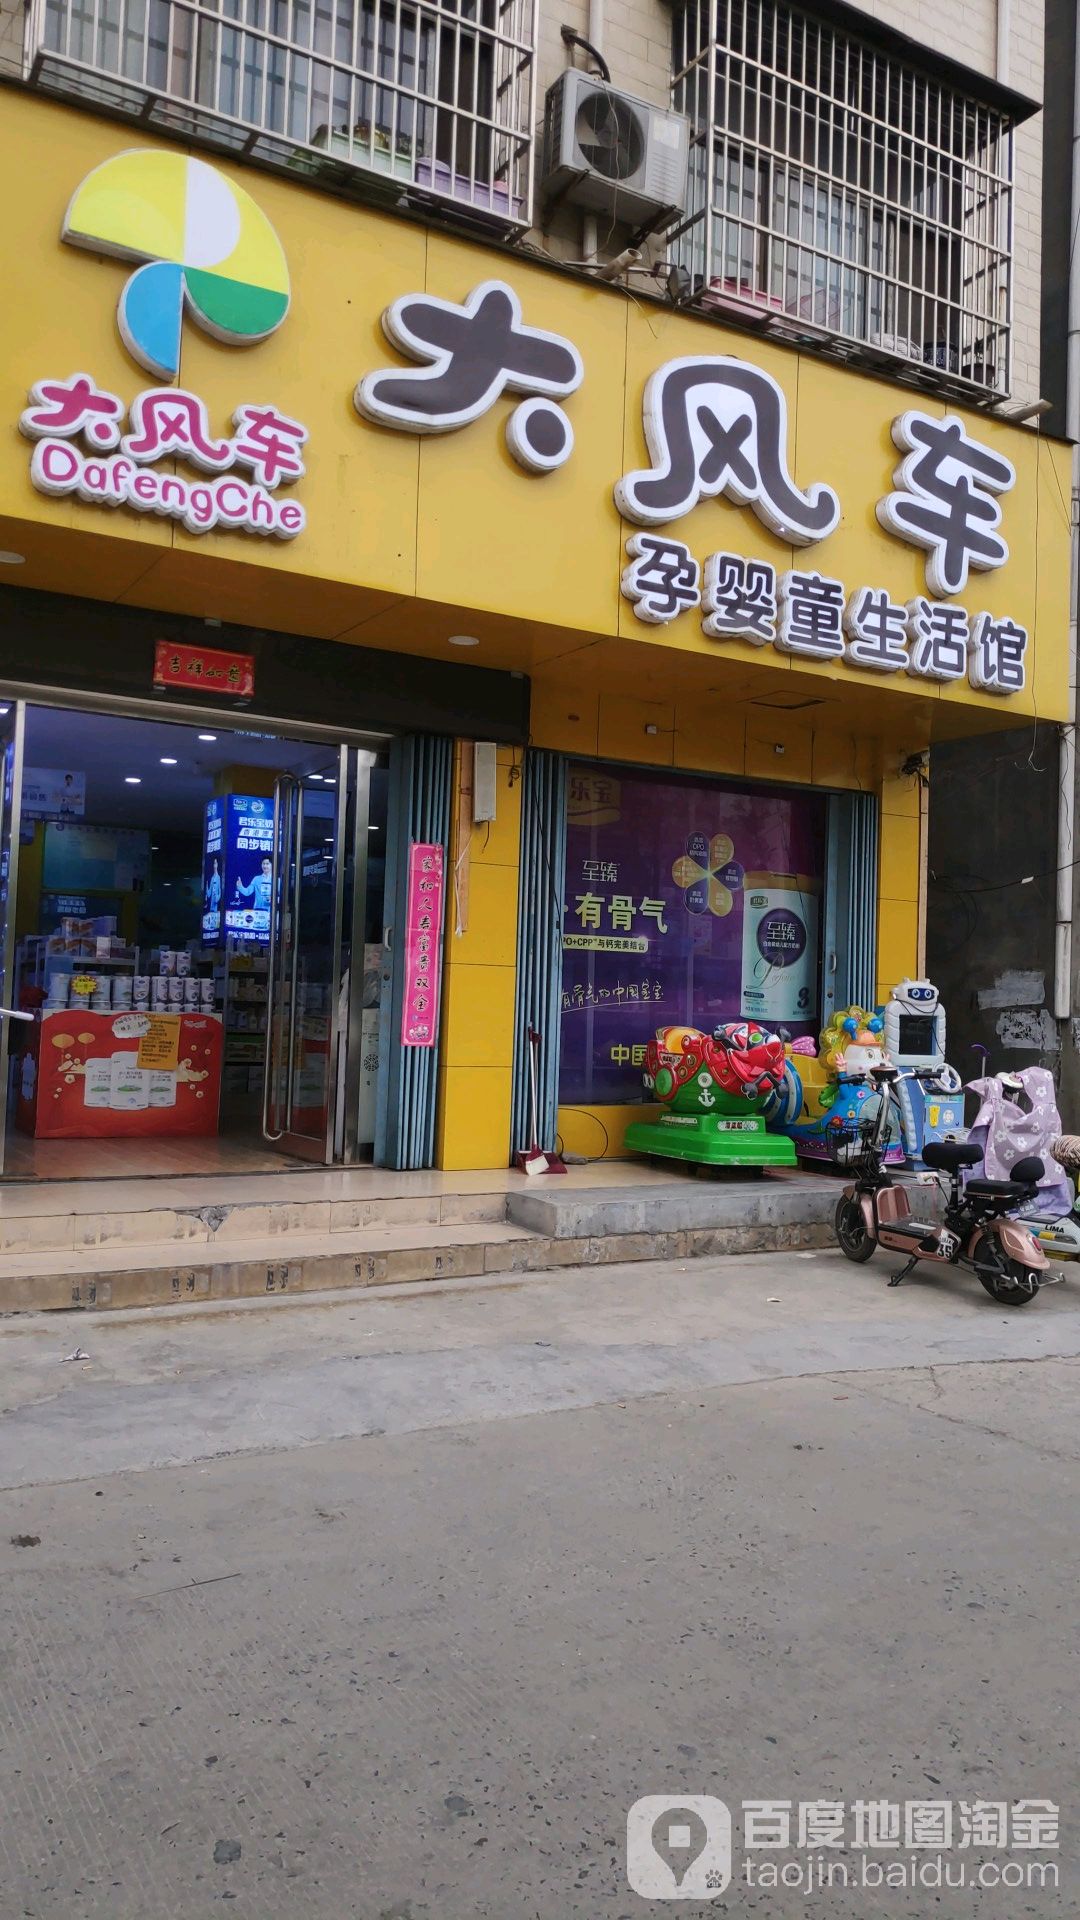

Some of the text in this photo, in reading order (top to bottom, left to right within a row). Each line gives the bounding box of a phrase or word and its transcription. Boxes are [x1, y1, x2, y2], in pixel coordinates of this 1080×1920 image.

[30, 379, 304, 482] 大风车
[368, 286, 1013, 589] 大风车
[42, 443, 302, 530] DafengChe
[635, 537, 1028, 689] 孕婴童生活馆
[169, 653, 241, 683] 吉祥如意
[582, 859, 618, 883] 至臻
[1044, 1224, 1065, 1234] LIMA
